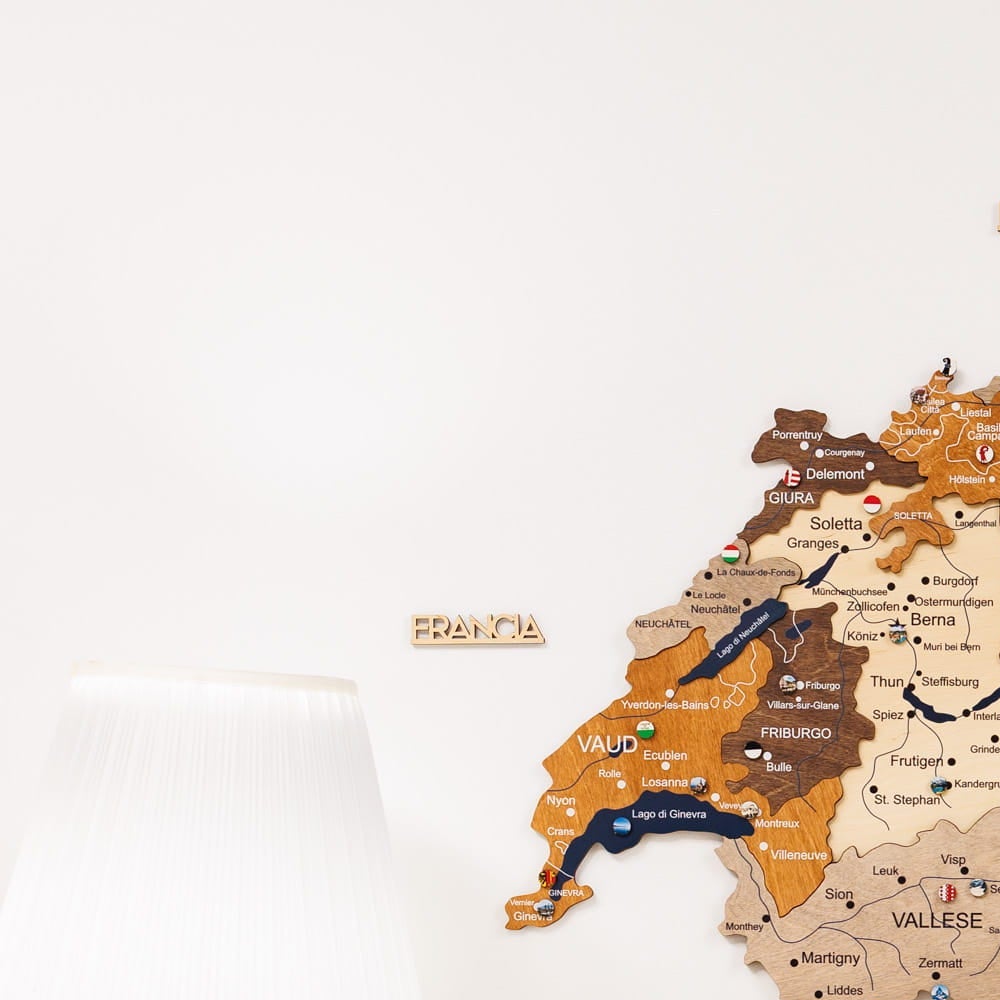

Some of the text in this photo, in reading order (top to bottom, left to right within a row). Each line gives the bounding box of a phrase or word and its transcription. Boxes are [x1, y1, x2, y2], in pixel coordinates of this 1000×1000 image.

[961, 408, 991, 418] Liestal
[773, 430, 823, 442] Porrentruy
[900, 427, 932, 437] Laufen
[824, 448, 865, 458] Courgenay
[806, 468, 865, 480] Delemont
[769, 492, 814, 504] GIURA
[894, 511, 932, 520] SOLETTA
[810, 517, 863, 531] Soletta
[787, 538, 839, 551] Granges
[717, 568, 796, 577] La Chaux-de-Fonds
[933, 576, 979, 586] Burgdorf
[812, 588, 888, 596] Münchenbuchsee
[847, 602, 900, 612] Zollicofen
[914, 597, 994, 608] Ostermundigen
[691, 604, 741, 614] Neuchâtel
[635, 619, 692, 629] NEUCHÂTEL
[911, 613, 956, 626] Berna
[411, 614, 545, 641] FRANCIA
[847, 631, 879, 642] Köniz
[924, 643, 981, 651] Muri bei Bern
[805, 682, 841, 691] Friburgo
[870, 676, 904, 688] Thun
[921, 676, 979, 688] Steffisburg
[621, 700, 710, 710] Yverdon-les-Bains
[872, 710, 904, 721] Spiez
[760, 728, 832, 739] FRIBURGO
[577, 735, 638, 753] VAUD
[643, 750, 688, 761] Ecublen
[766, 762, 792, 772] Bulle
[890, 755, 944, 768] Frutigen
[598, 769, 622, 778] Rolle
[641, 777, 688, 788] Losanna
[546, 795, 576, 807] Nyon
[874, 795, 941, 808] St. Stephan
[631, 809, 707, 821] Lago di Ginevra
[755, 819, 800, 828] Montreux
[547, 826, 575, 836] Crans
[770, 850, 828, 860] Villeneuve
[941, 854, 966, 867] Visp
[872, 865, 899, 876] Leuk
[548, 889, 584, 897] GINEVRA
[825, 888, 854, 900] Sion
[892, 912, 983, 929] VALLESE
[725, 922, 764, 932] Monthey
[801, 952, 861, 967] Martigny
[918, 957, 963, 969] Zermatt
[827, 986, 863, 996] Liddes
